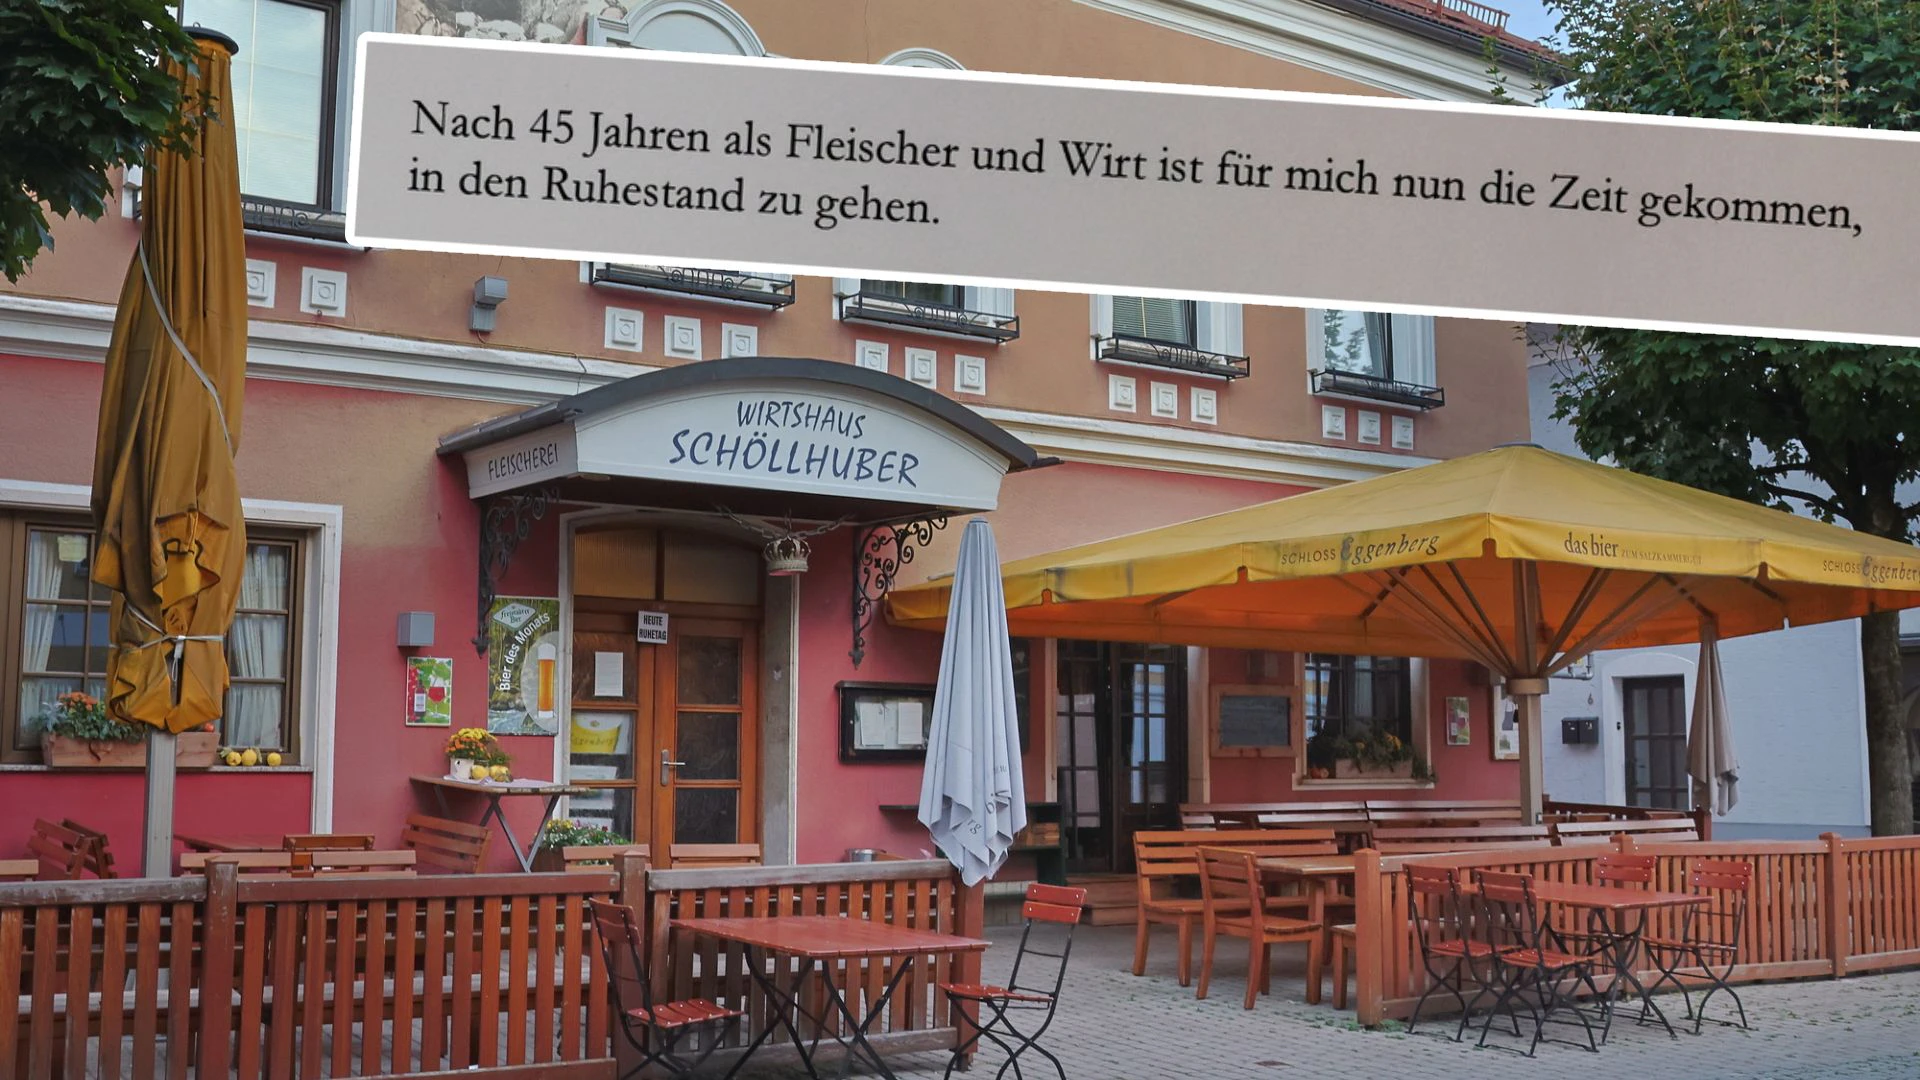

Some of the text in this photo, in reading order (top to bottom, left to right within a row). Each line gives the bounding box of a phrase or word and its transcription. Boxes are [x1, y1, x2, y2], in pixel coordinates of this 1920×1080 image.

[736, 400, 867, 439] WIRTSHAUS
[488, 442, 559, 480] FLEISCHEREI
[668, 428, 920, 488] SCHÖLLHUBER
[1281, 533, 1440, 566] SCHLOSS Eggenberg
[1564, 531, 1588, 555] das
[1591, 533, 1619, 558] bier
[1823, 555, 1920, 584] SCHLOSS Eggenber
[638, 628, 667, 641] RUHETAG
[643, 614, 664, 626] HEUTE
[500, 612, 551, 691] Bier des Monats
